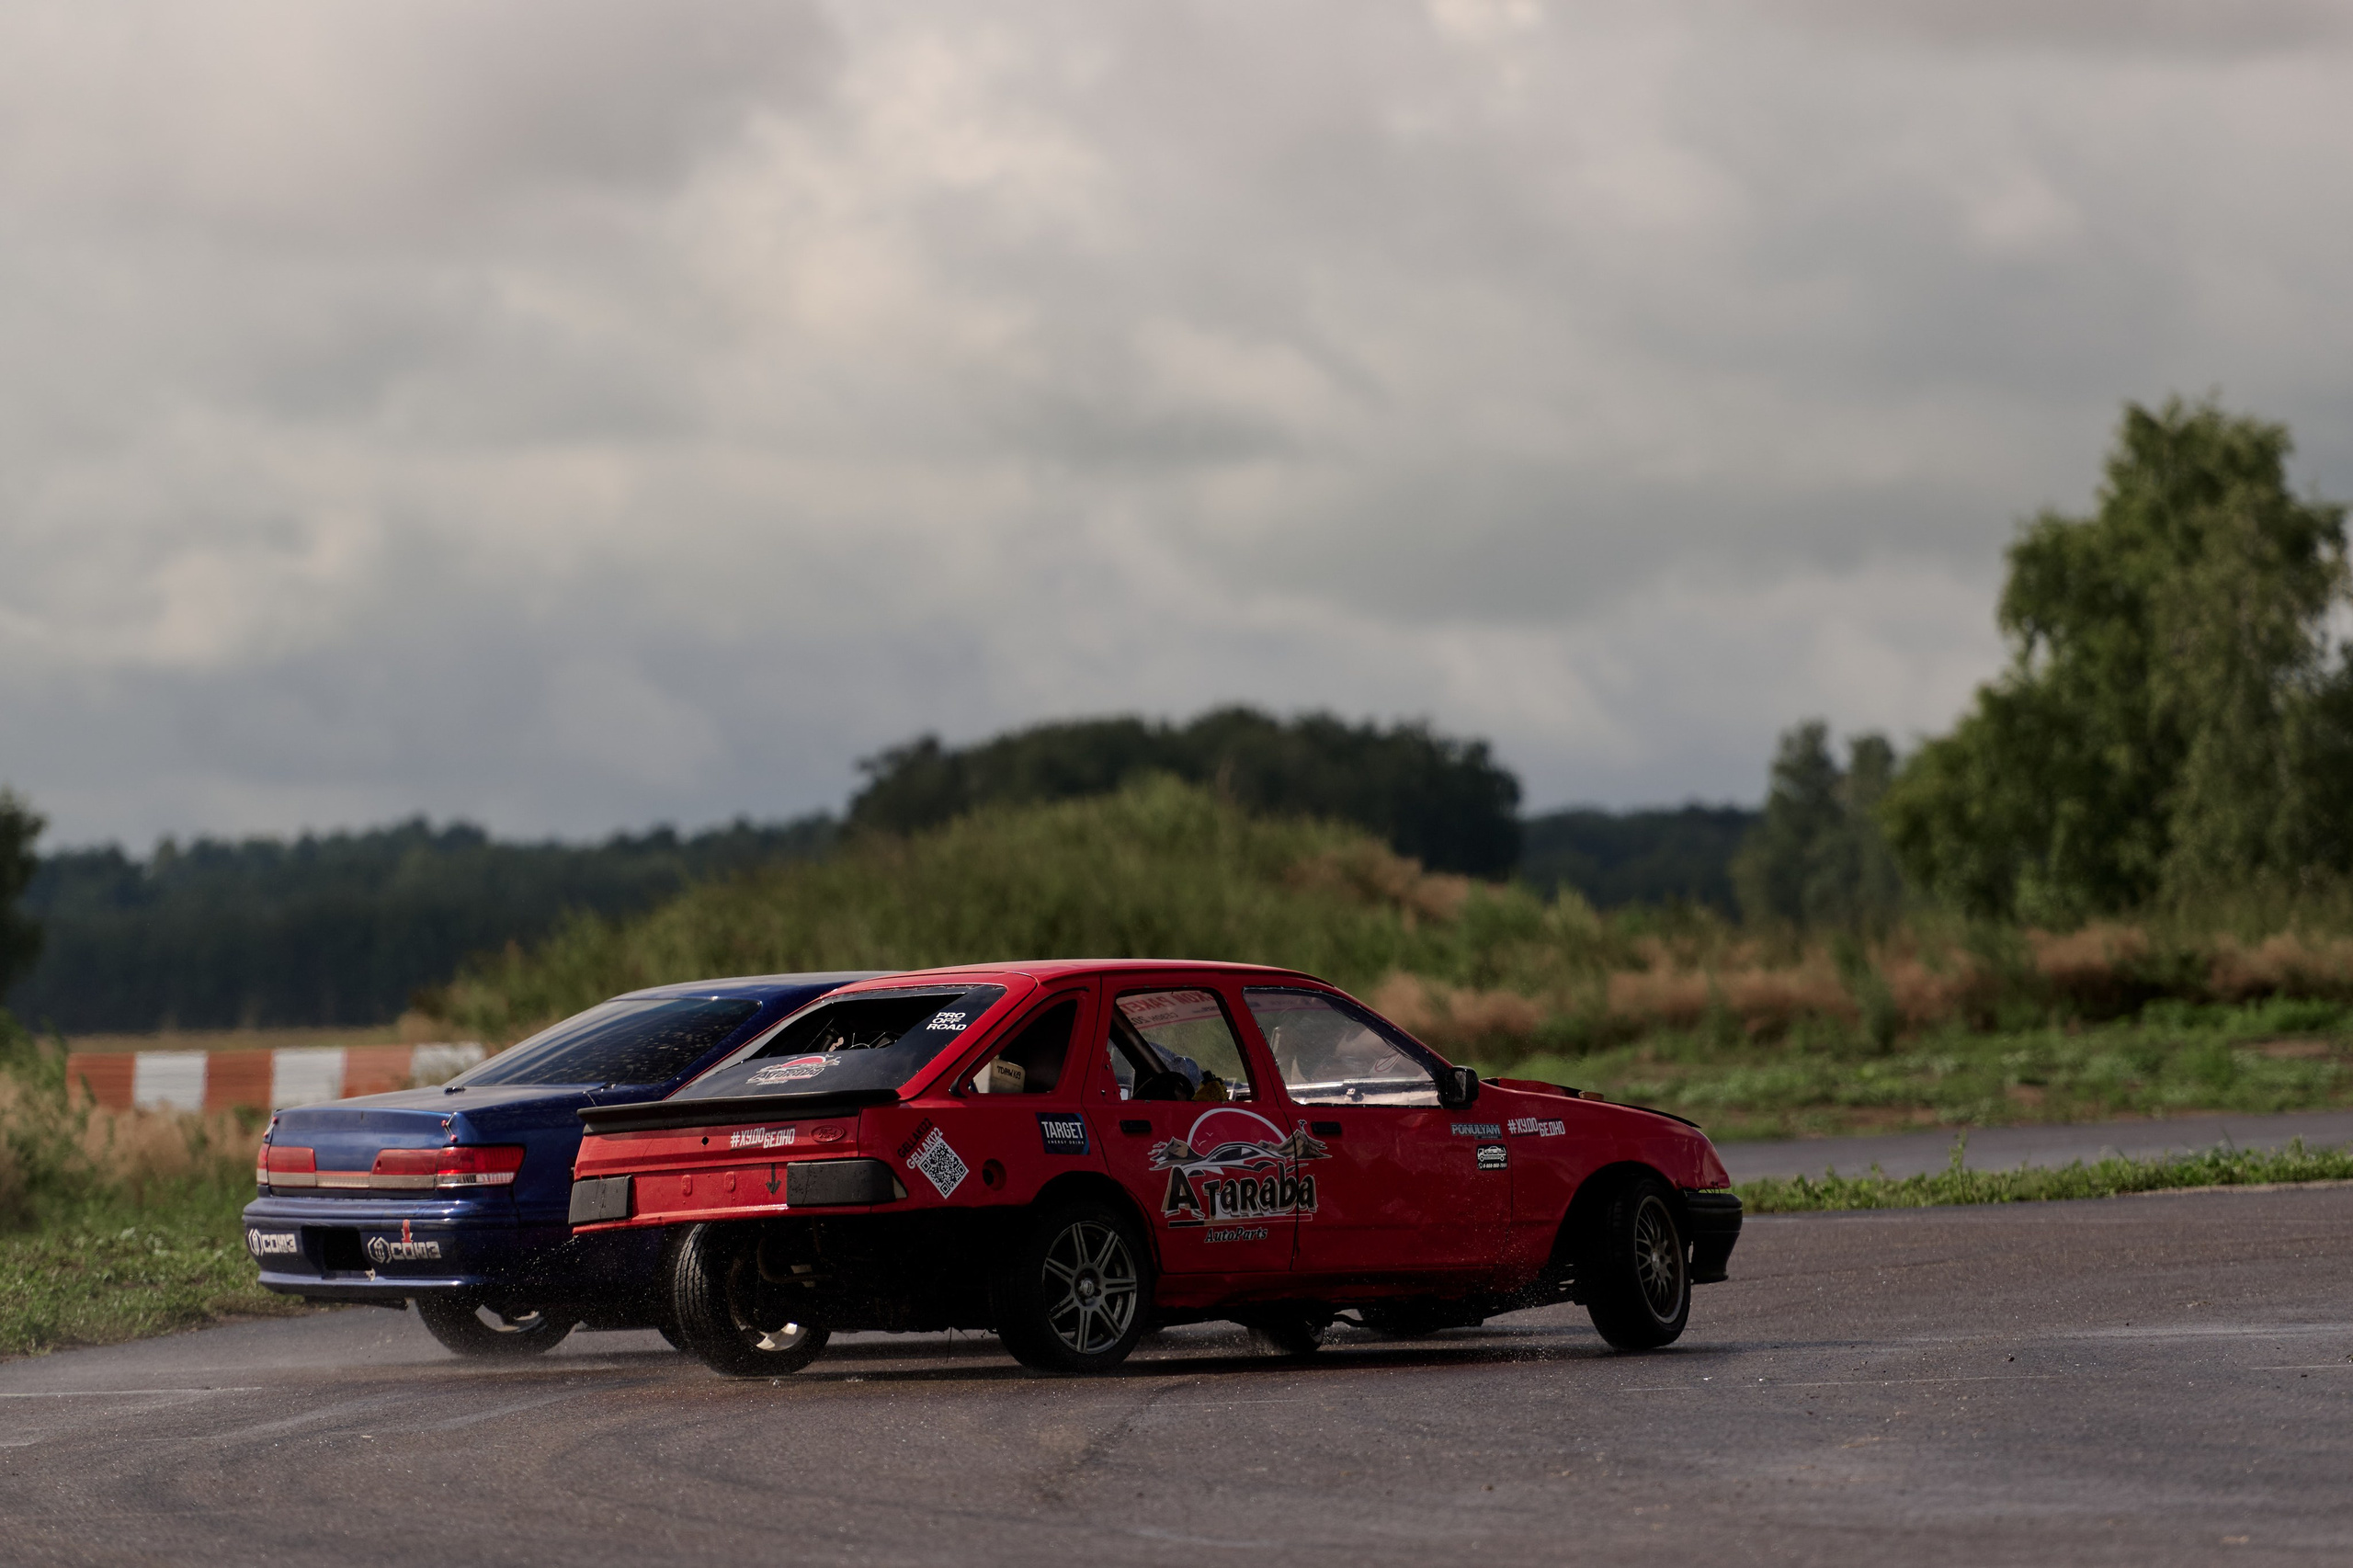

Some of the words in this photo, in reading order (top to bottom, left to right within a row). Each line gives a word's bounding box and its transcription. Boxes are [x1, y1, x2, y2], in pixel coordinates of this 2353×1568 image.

[897, 1117, 934, 1158] GELLAKI22
[1041, 1121, 1084, 1139] TARGET
[1451, 1124, 1501, 1135] PONULYAM
[906, 1127, 944, 1170] GELLAKI22
[1204, 1227, 1268, 1243] AutoParts
